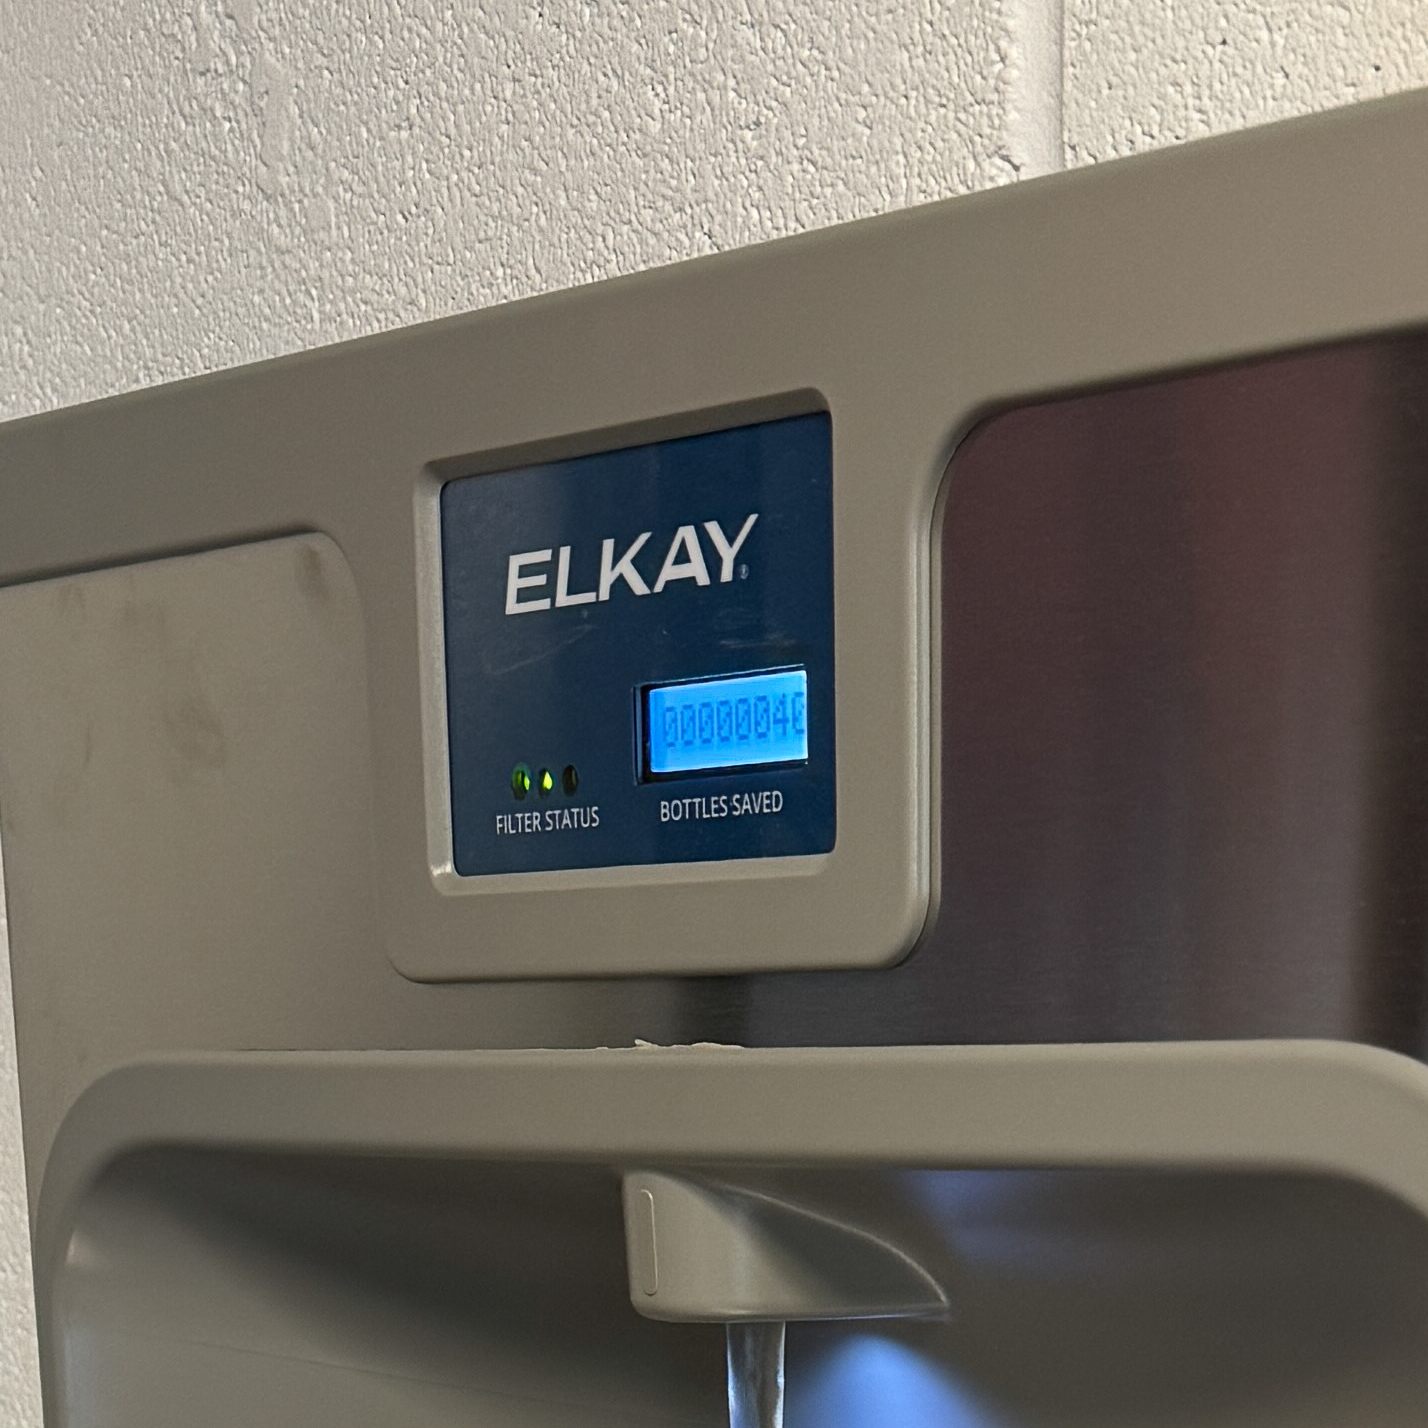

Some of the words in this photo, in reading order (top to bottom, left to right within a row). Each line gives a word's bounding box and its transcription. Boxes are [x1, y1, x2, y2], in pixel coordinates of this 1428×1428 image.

[505, 513, 759, 615] ELKAY
[496, 812, 542, 835] FILTER
[545, 806, 600, 832] STATUS
[660, 794, 729, 823] BOTTLES
[731, 790, 783, 816] SAVED
